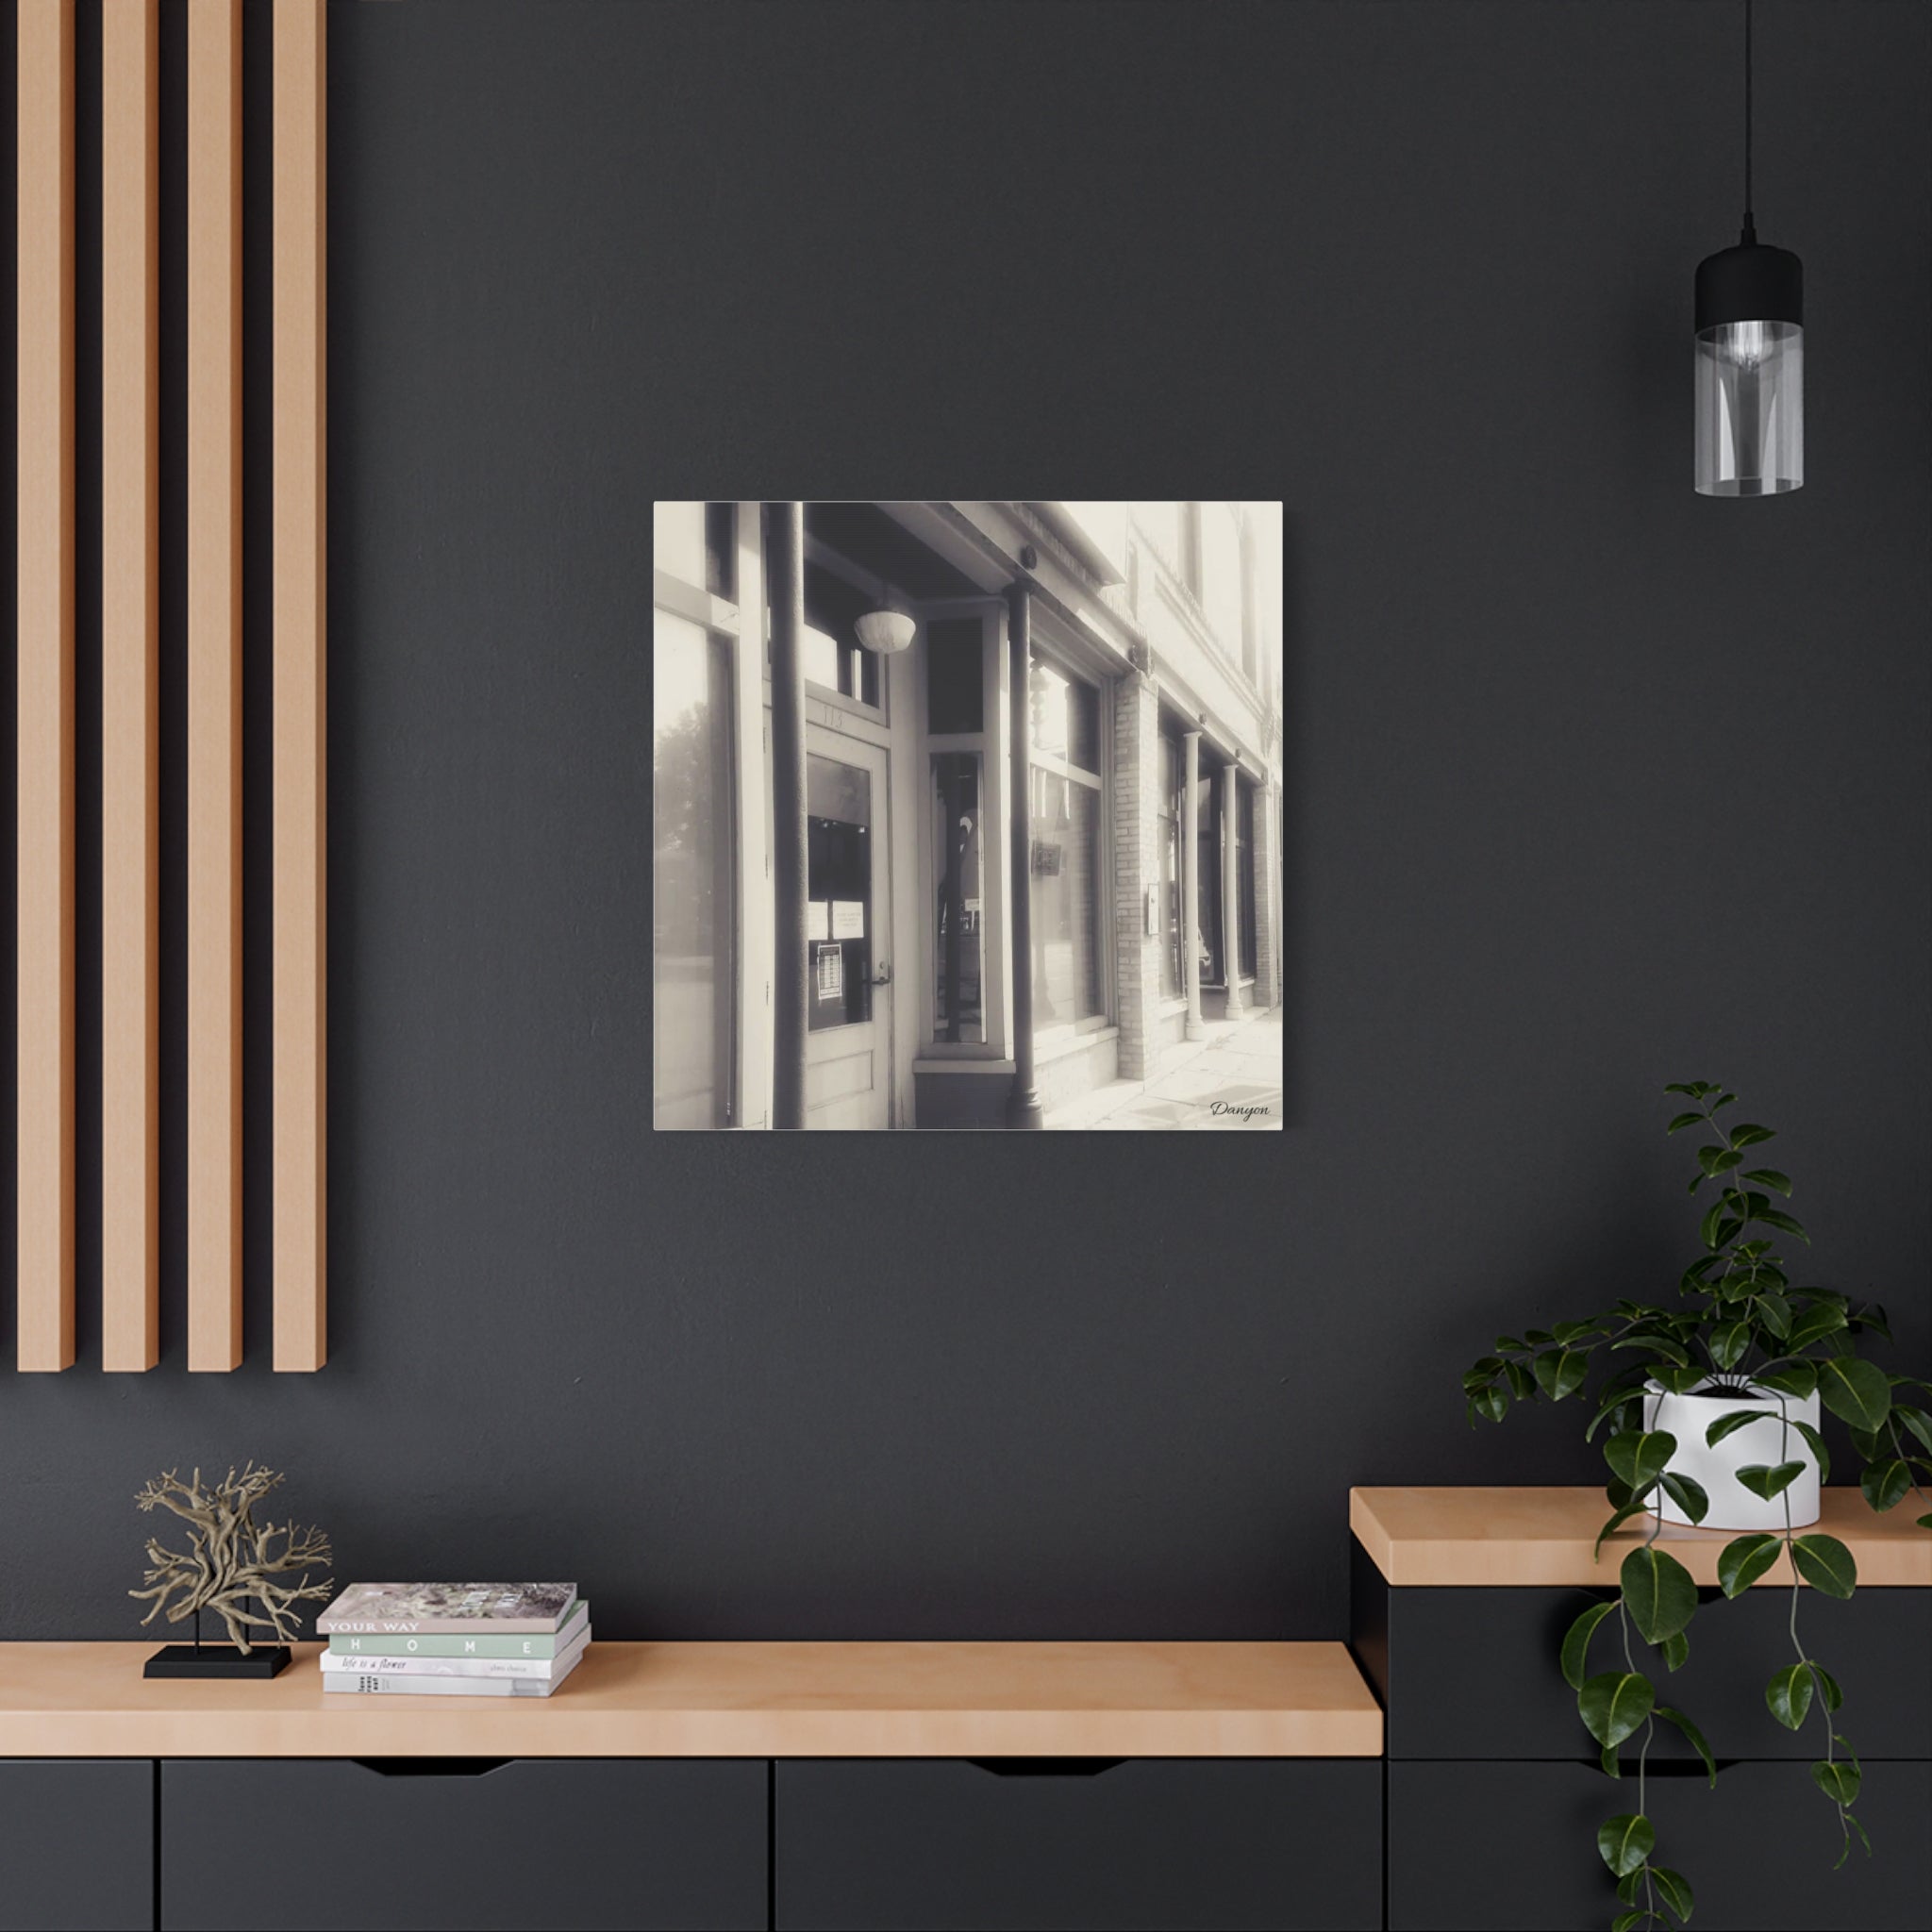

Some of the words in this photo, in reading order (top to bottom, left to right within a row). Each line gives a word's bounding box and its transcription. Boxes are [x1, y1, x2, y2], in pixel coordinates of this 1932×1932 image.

[1209, 1100, 1272, 1123] Danyon
[327, 1622, 377, 1632] YOUR
[382, 1622, 420, 1632] WAY
[341, 1657, 357, 1671] life
[376, 1657, 407, 1672] flower
